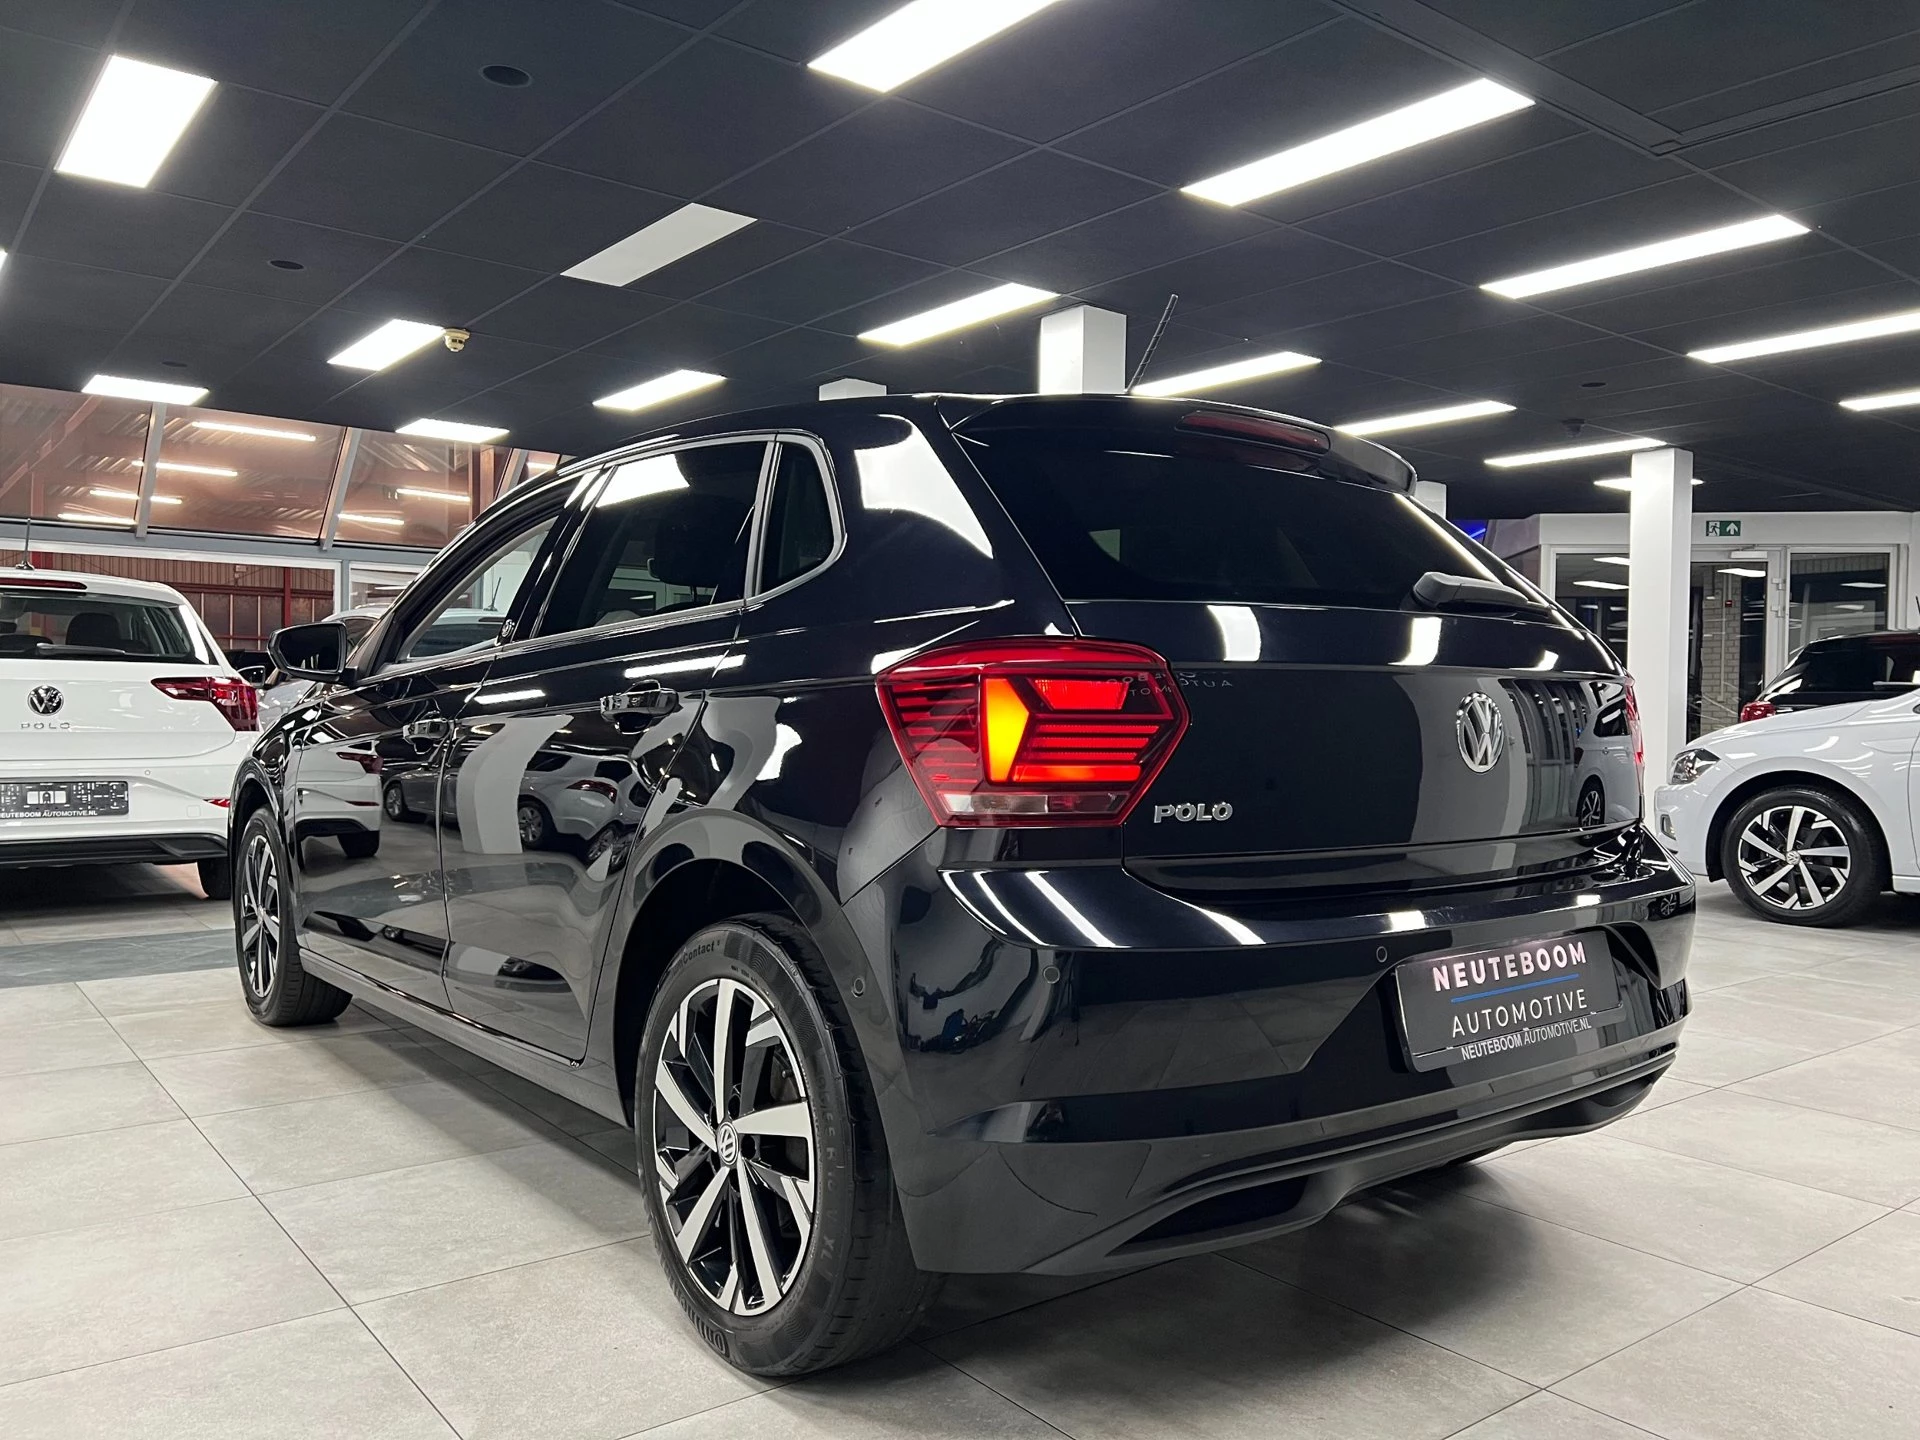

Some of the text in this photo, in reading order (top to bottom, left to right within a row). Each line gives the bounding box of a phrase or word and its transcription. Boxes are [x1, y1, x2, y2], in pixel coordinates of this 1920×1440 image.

[20, 722, 71, 730] POLO
[0, 811, 41, 819] EUTEBOOM
[1153, 801, 1234, 824] POLO
[1432, 941, 1587, 992] NEUTEBOOM
[1452, 988, 1588, 1038] AUTOMOTIVE
[1461, 1017, 1592, 1061] NEUTEBOOM AUTOMOTIVE.NL
